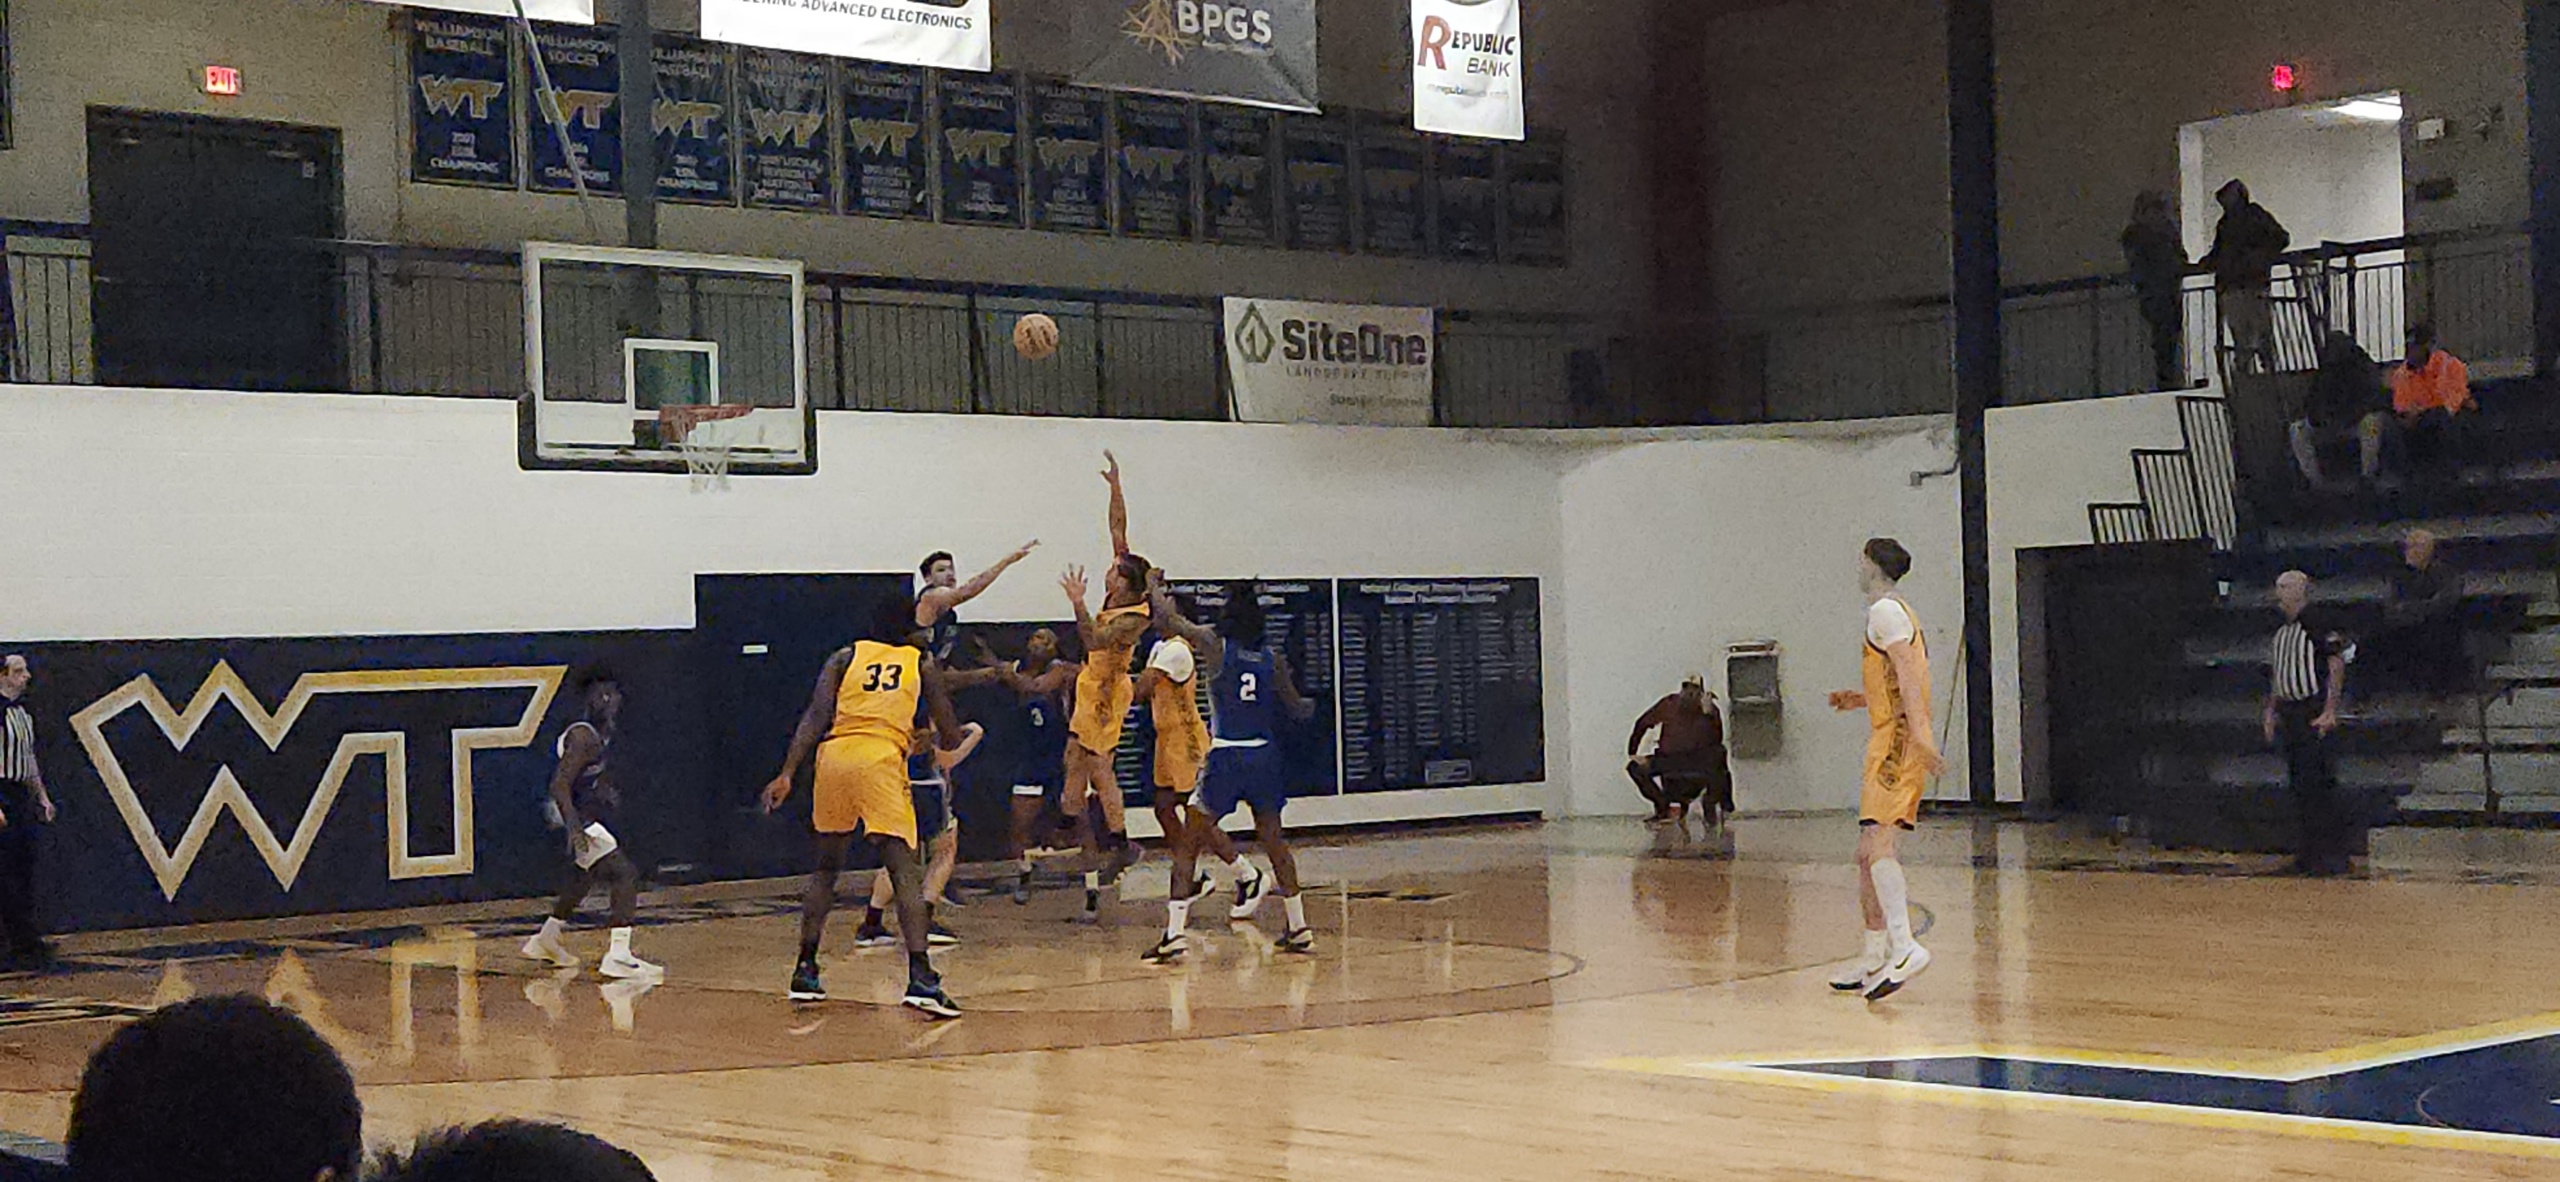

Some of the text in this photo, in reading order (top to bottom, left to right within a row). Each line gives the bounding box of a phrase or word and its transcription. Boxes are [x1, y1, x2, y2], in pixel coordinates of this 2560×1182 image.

[413, 19, 507, 43] WILLIAMSON
[881, 7, 973, 30] ELECTRONICS
[1177, 0, 1272, 44] BPGS
[425, 34, 494, 55] BASEBALL
[1417, 15, 1516, 71] REPUBLIC
[1467, 57, 1511, 77] BANK
[418, 74, 504, 119] WT
[652, 99, 724, 139] WT
[751, 109, 828, 148] WT
[849, 117, 920, 156] WT
[944, 127, 1016, 167] WT
[1034, 136, 1100, 175] WT
[1282, 319, 1427, 365] SiteOne
[862, 663, 902, 691] 33
[1240, 672, 1256, 701] 2
[1031, 707, 1044, 726] 3
[69, 659, 568, 902] WT
